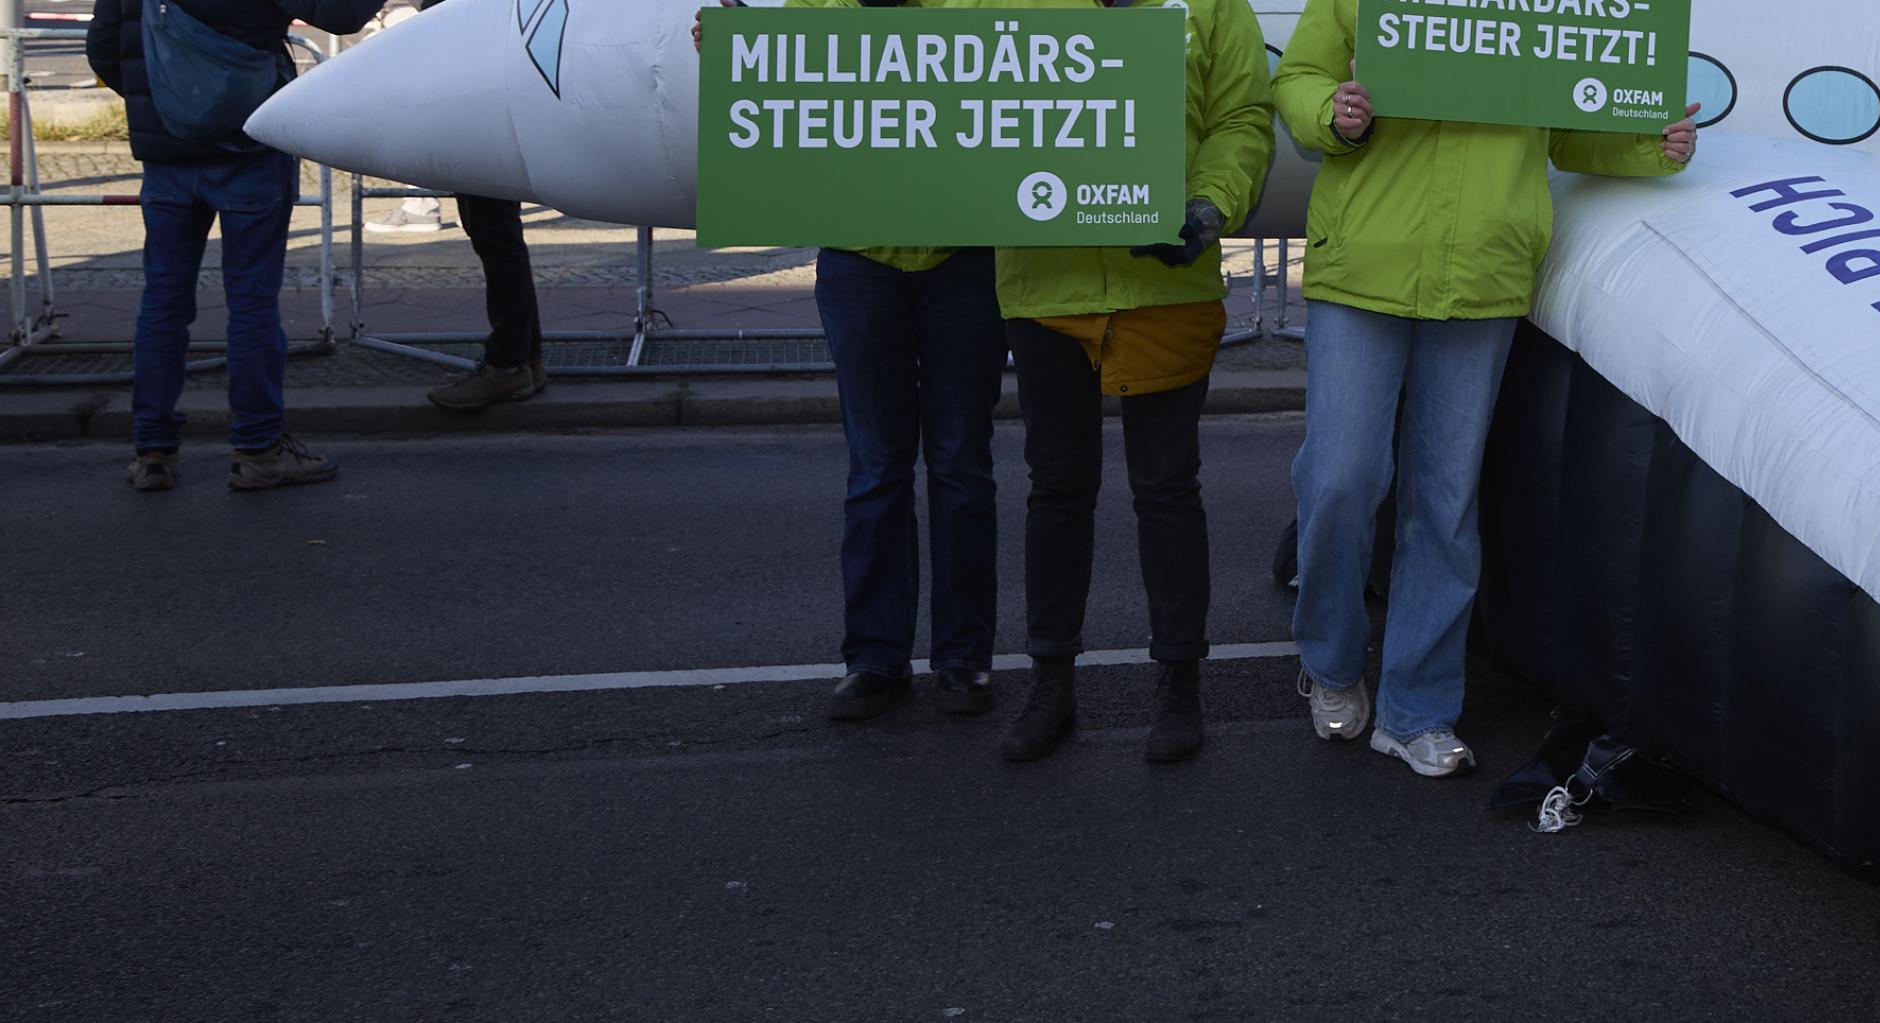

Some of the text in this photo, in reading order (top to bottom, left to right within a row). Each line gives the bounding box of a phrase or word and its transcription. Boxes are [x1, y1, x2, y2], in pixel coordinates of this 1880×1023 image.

[1378, 13, 1656, 67] STEUER JETZT!
[730, 21, 1124, 83] MILLIARDÄRS-
[1612, 87, 1664, 108] OXFAM
[728, 98, 1136, 148] STEUER JETZT!
[1612, 106, 1669, 121] Deutschland
[1076, 183, 1149, 206] OXFAM
[1076, 210, 1159, 224] Deutschland
